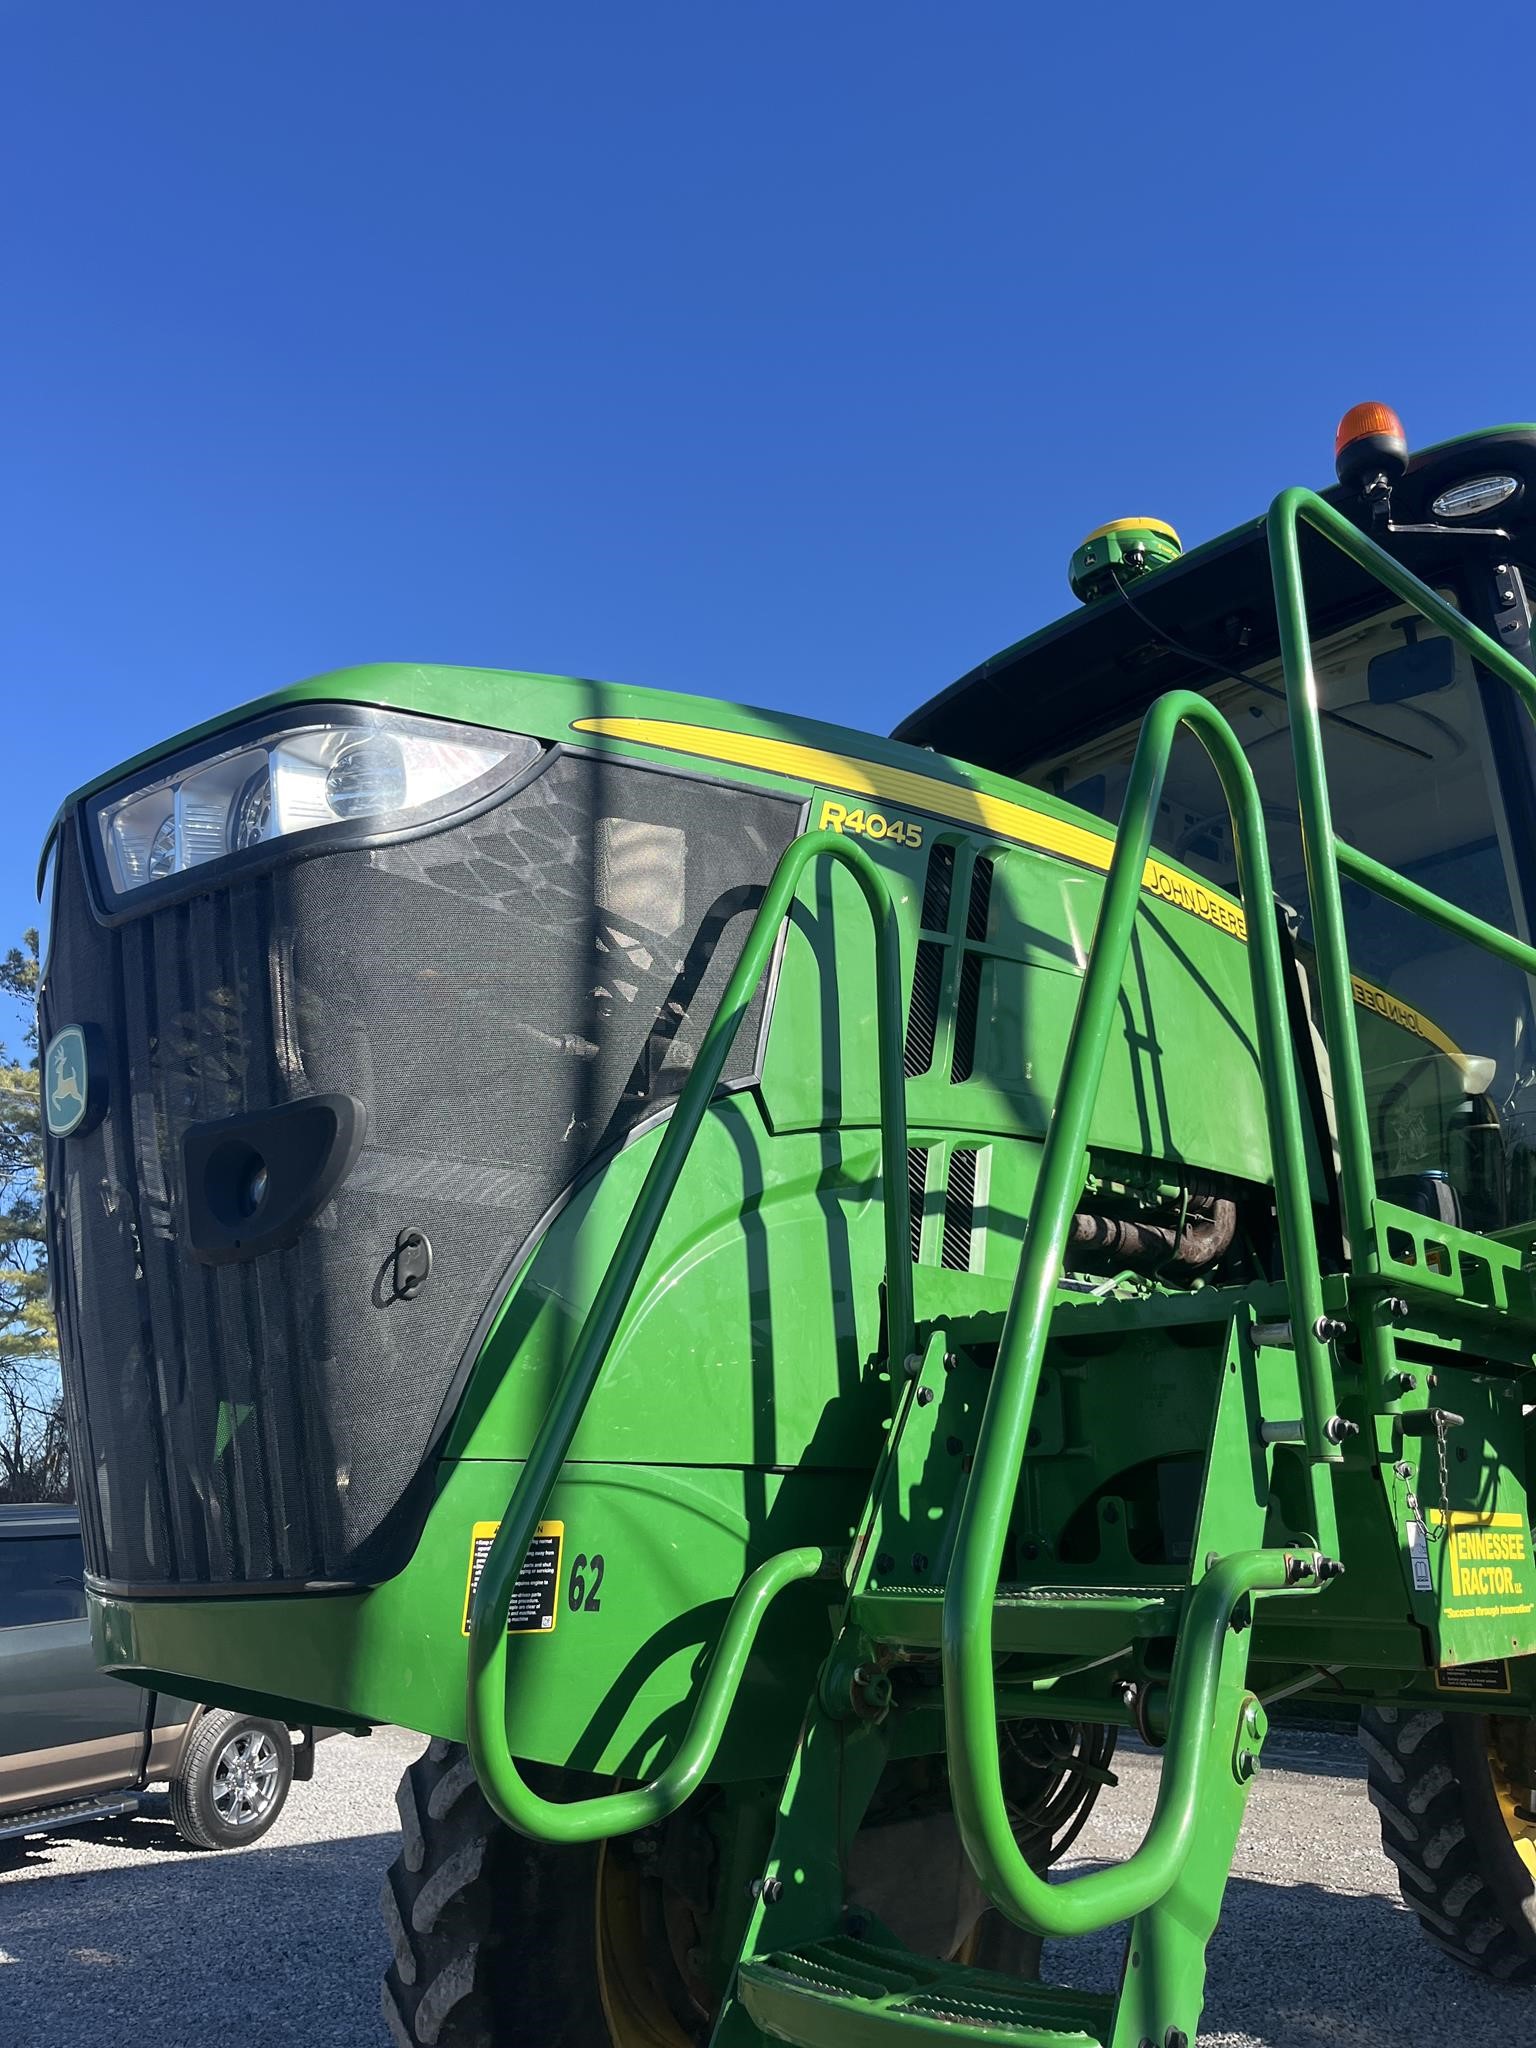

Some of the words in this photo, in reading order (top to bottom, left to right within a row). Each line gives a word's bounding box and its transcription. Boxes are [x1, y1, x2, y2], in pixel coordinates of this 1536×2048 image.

[819, 800, 922, 848] R4045
[1447, 1527, 1525, 1560] TENNESSEE
[569, 1553, 605, 1612] 62
